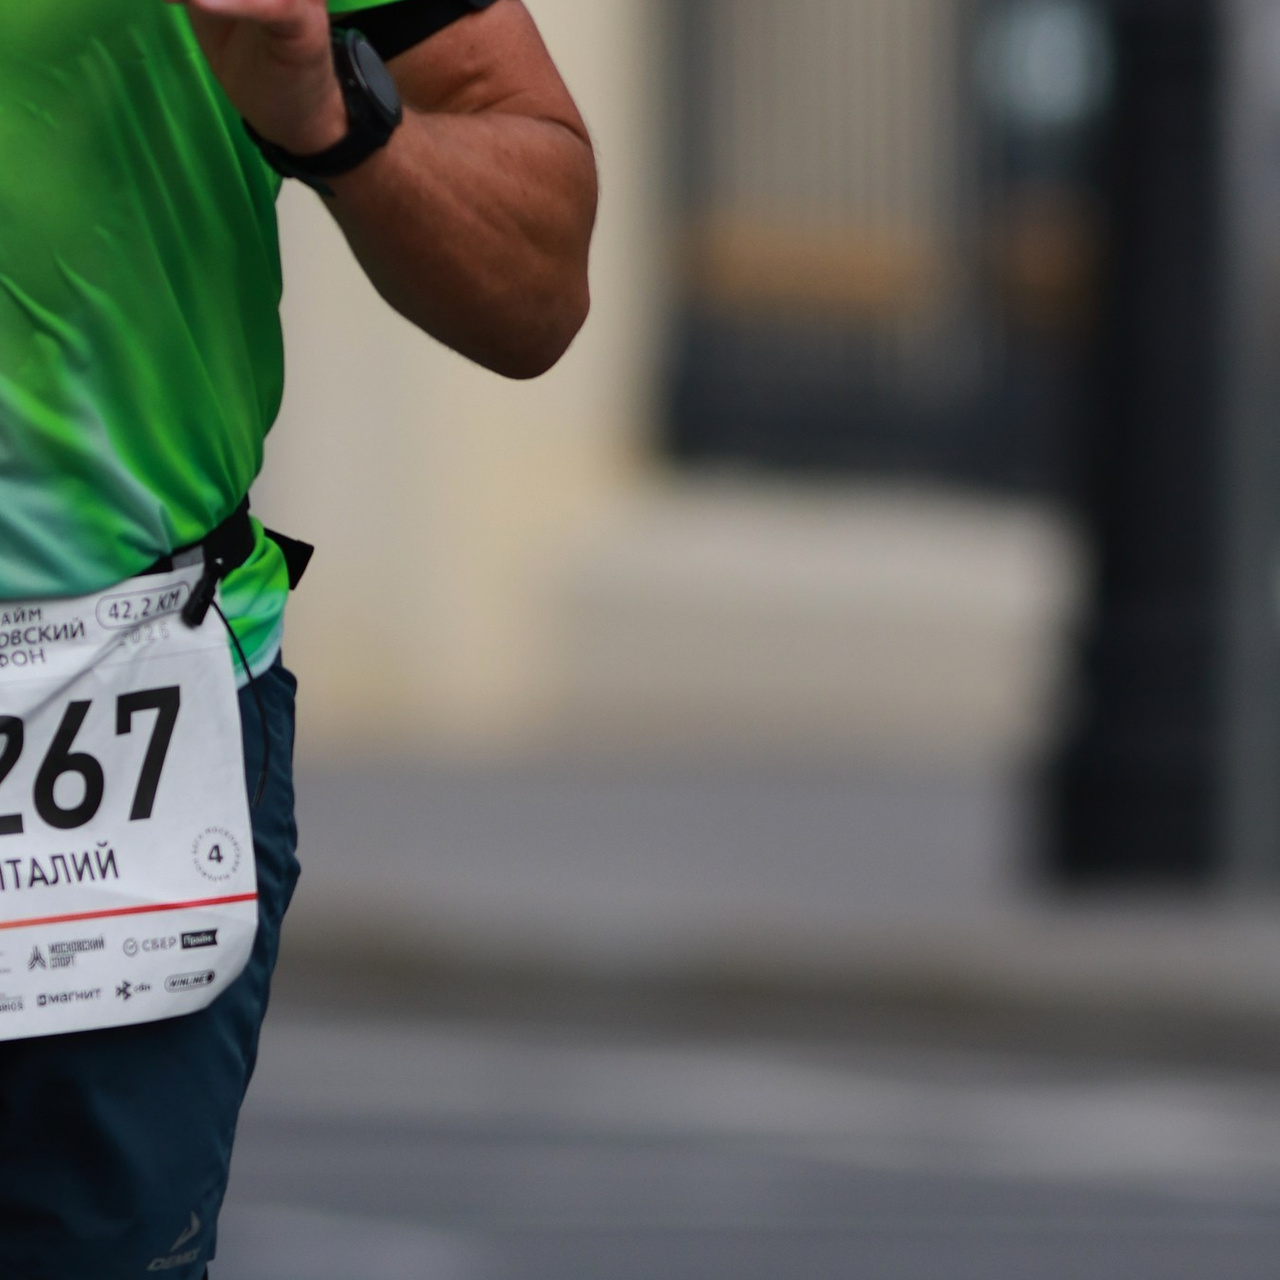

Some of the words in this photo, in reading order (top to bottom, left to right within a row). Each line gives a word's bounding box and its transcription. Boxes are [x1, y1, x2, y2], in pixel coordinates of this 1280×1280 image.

[108, 597, 151, 620] 42,2
[208, 844, 223, 864] 4
[48, 936, 105, 955] МОСКОВСКИЙ
[141, 936, 177, 952] СБЕР
[48, 987, 102, 1004] магнит
